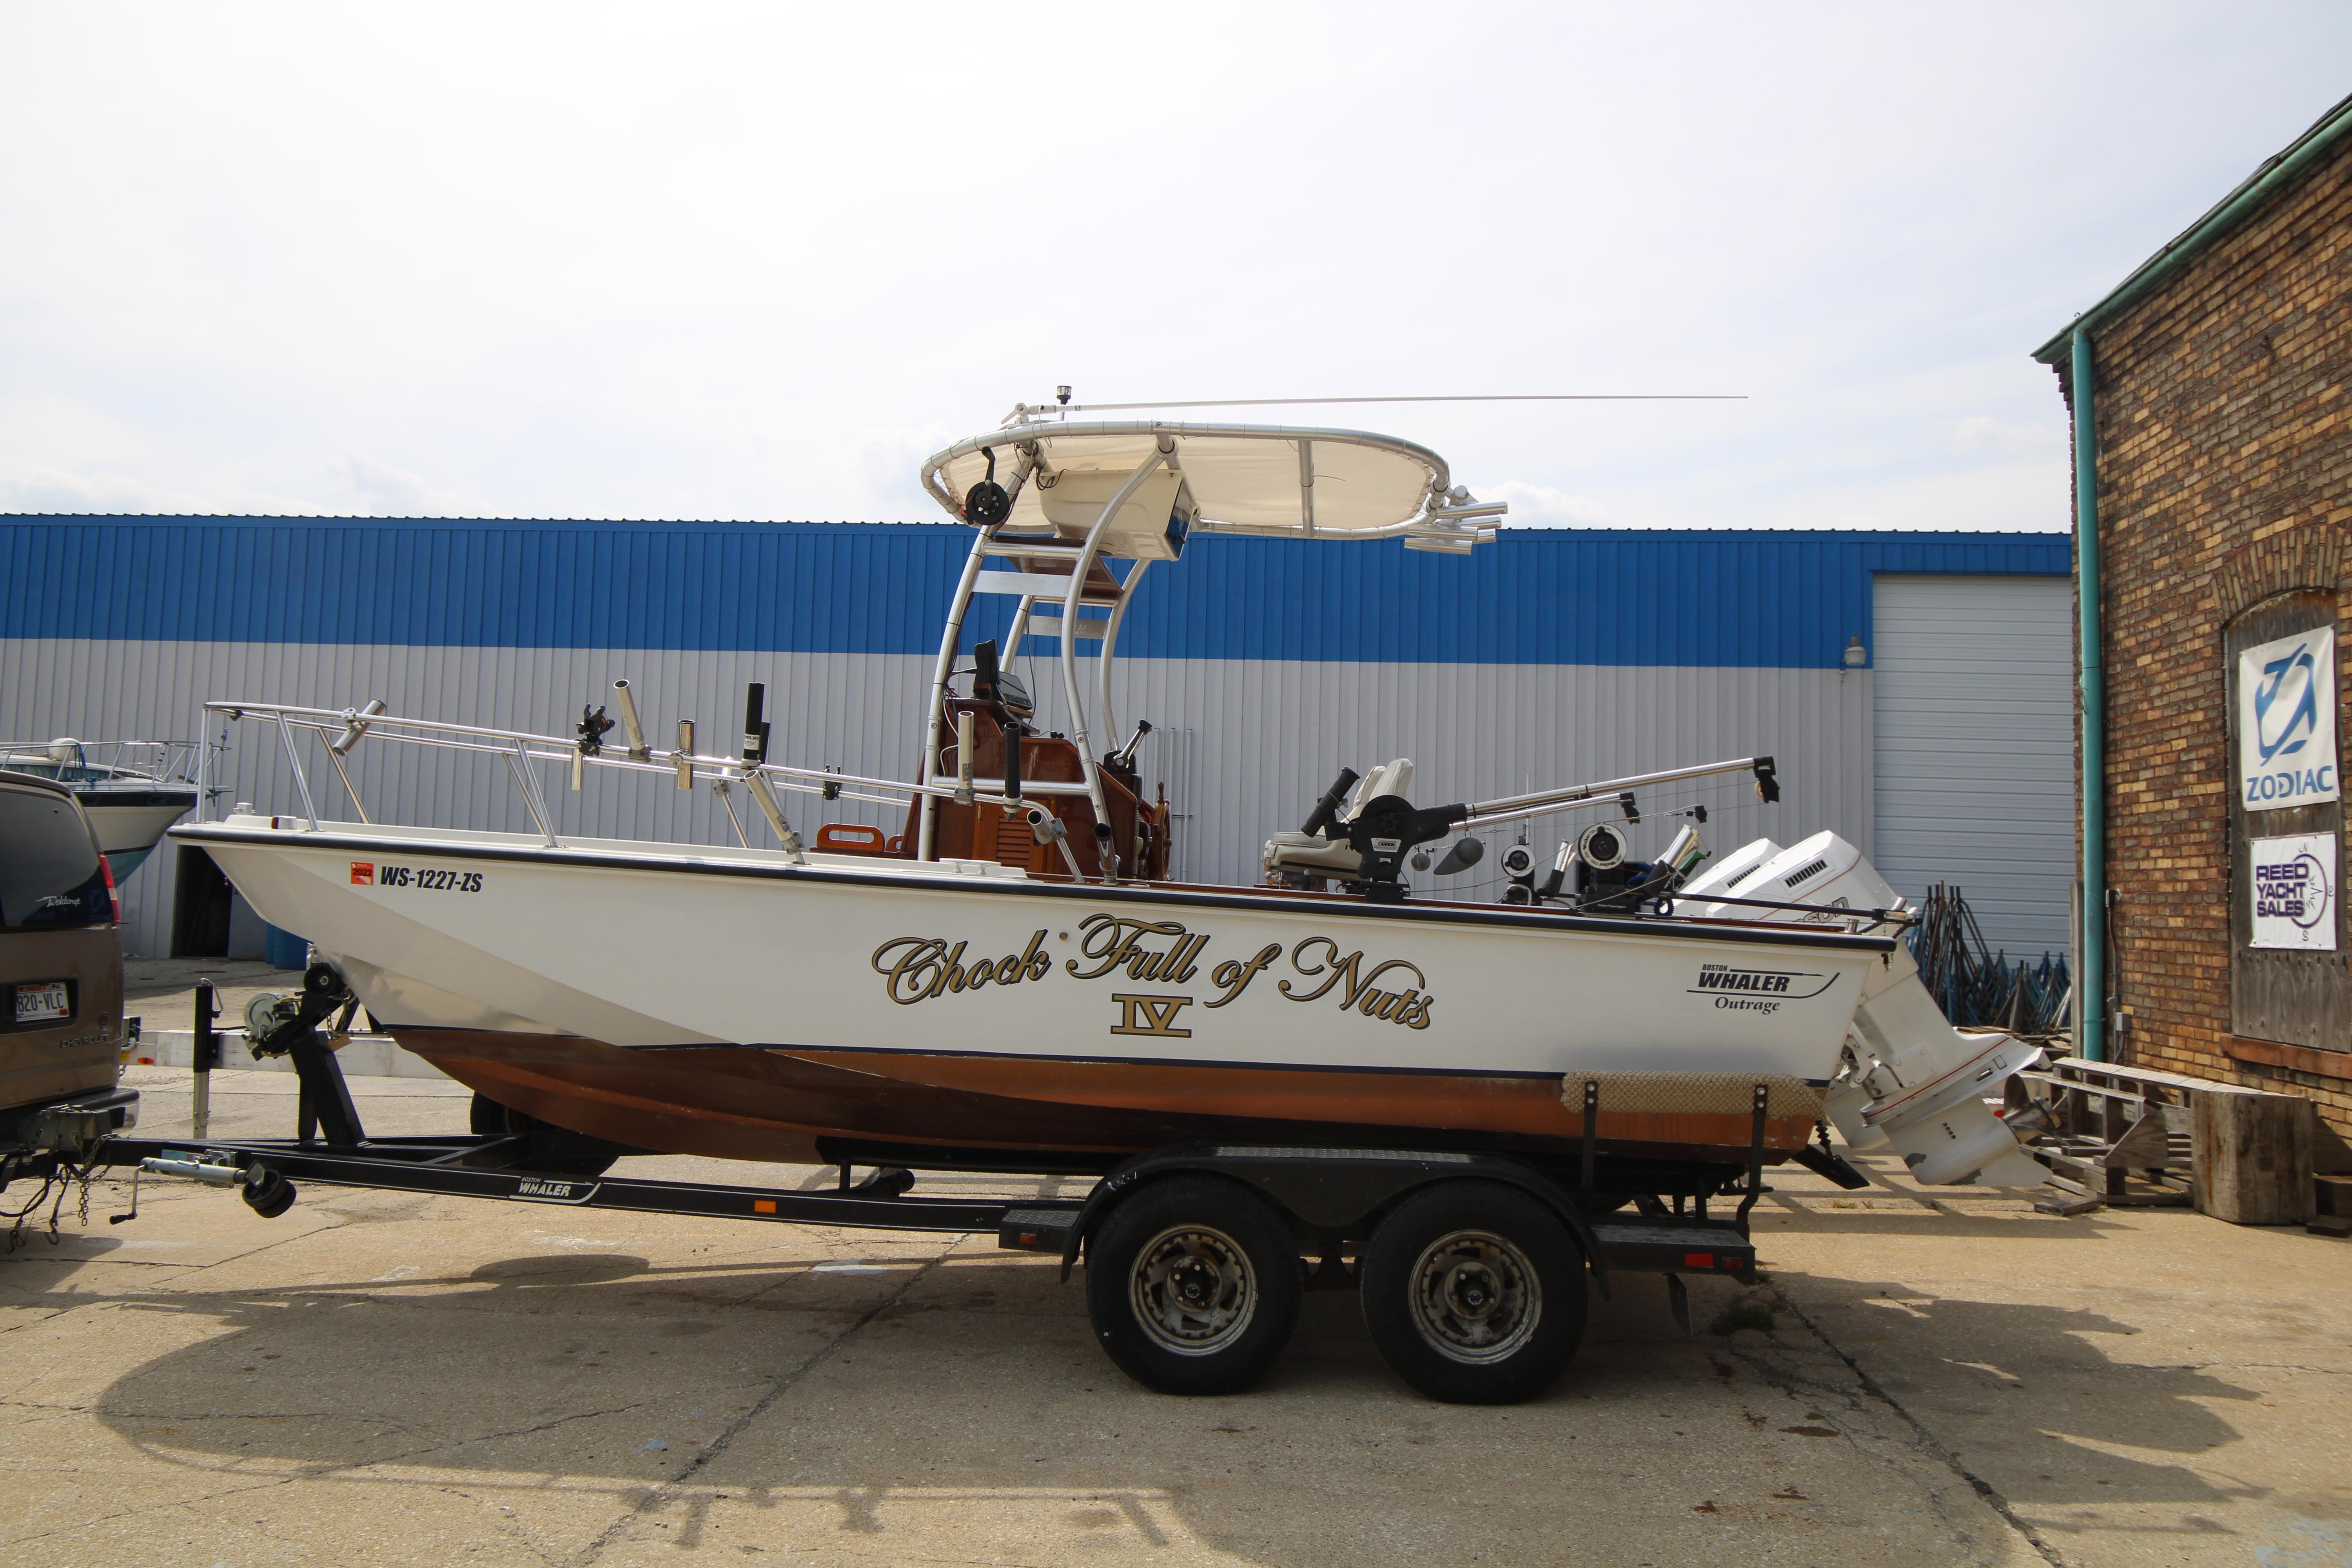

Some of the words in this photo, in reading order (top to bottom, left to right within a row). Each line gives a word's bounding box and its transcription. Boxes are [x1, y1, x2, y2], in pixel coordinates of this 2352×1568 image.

[2247, 766, 2334, 802] ZODIAC
[353, 868, 372, 877] 2022
[380, 866, 483, 893] WS-1227-ZS
[2256, 863, 2309, 881] REED
[2256, 882, 2307, 899] YACHT
[38, 896, 81, 907] Weldcraft
[2257, 900, 2304, 917] SALES
[871, 929, 1052, 1005] Chock
[1066, 913, 1211, 984] Full
[1203, 943, 1283, 1008] of
[1278, 936, 1434, 1030] Nuts
[1699, 972, 1790, 992] WHALER
[17, 992, 64, 1012] 820-VLC
[1715, 996, 1780, 1014] Outrage
[1111, 993, 1193, 1038] IV
[60, 1034, 109, 1048] CHEVROLET
[519, 1182, 571, 1197] WHALER
